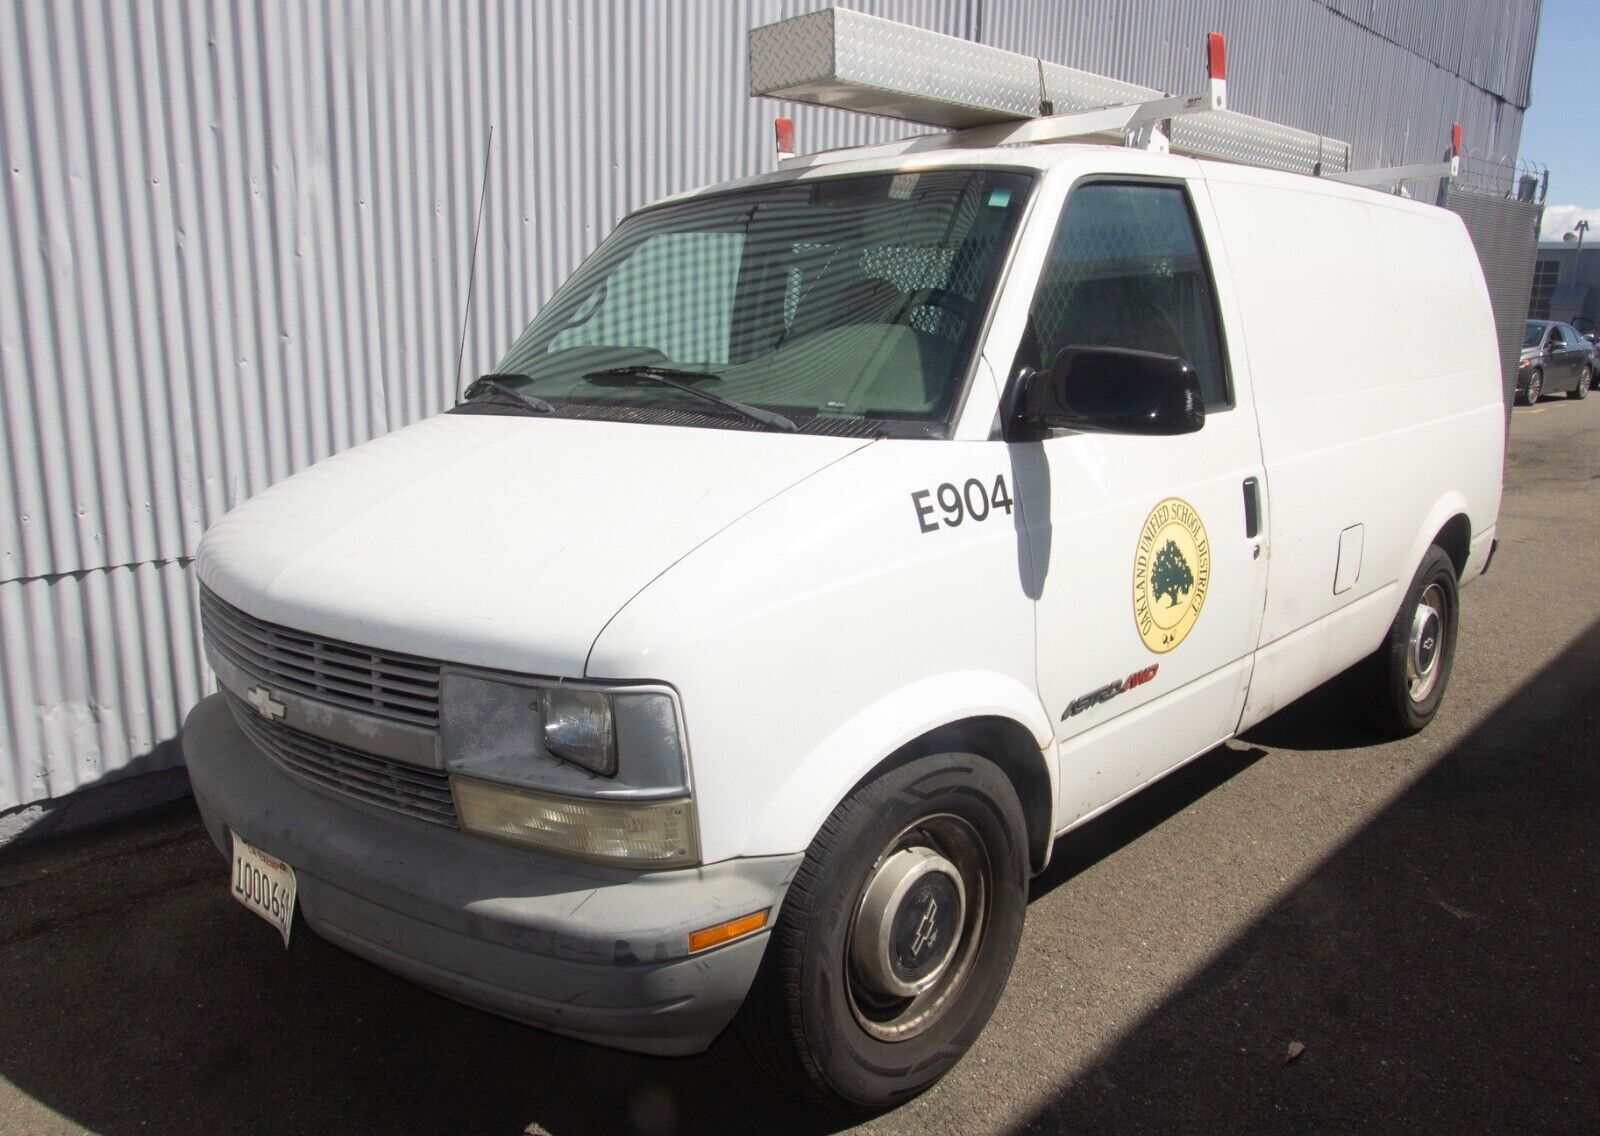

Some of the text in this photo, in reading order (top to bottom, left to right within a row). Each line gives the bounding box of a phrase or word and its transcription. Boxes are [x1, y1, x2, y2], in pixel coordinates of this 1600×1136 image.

[911, 474, 1013, 533] E904
[1136, 503, 1208, 636] OAKLAND UNIFIED SCHOOL DISTRICT
